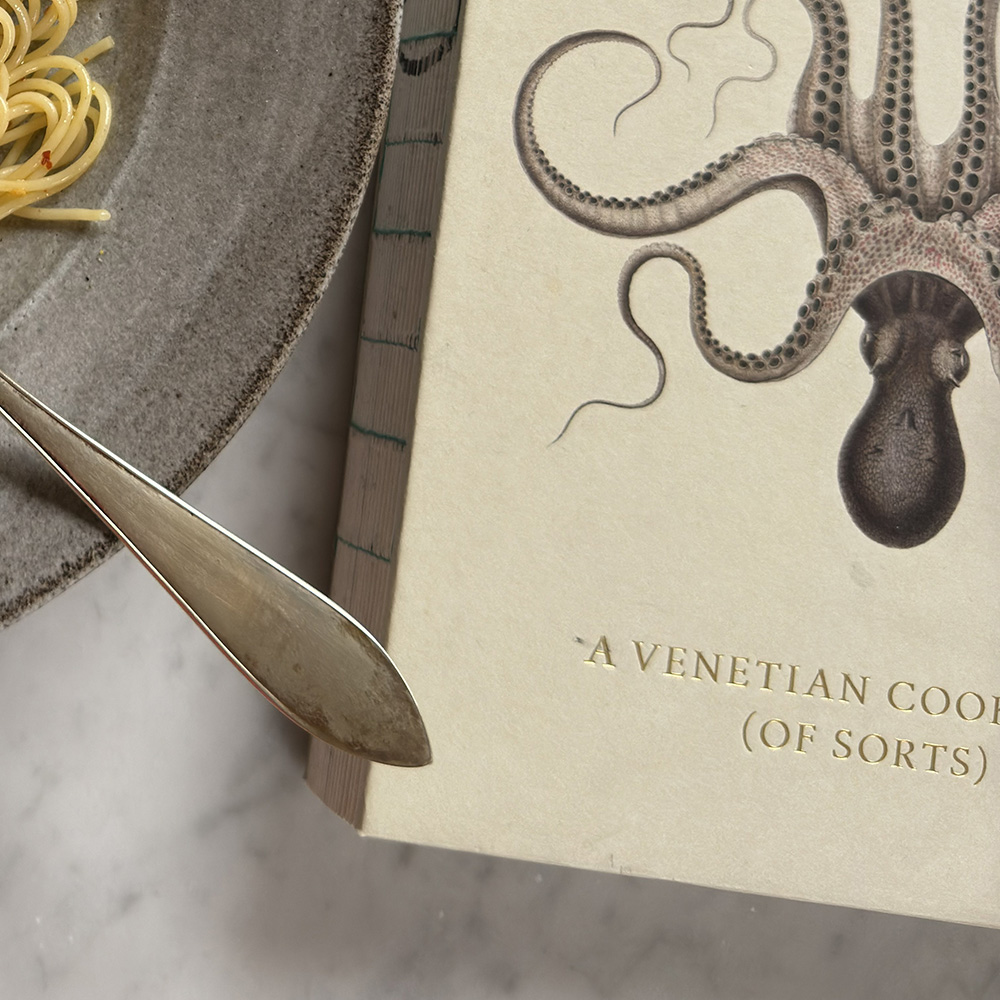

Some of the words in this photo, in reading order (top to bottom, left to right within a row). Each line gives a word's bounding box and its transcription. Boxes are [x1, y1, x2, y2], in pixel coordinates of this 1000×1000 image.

[583, 635, 616, 669] A
[632, 639, 872, 706] VENETIAN
[741, 710, 817, 755] (OF
[832, 728, 988, 786] SORTS)
